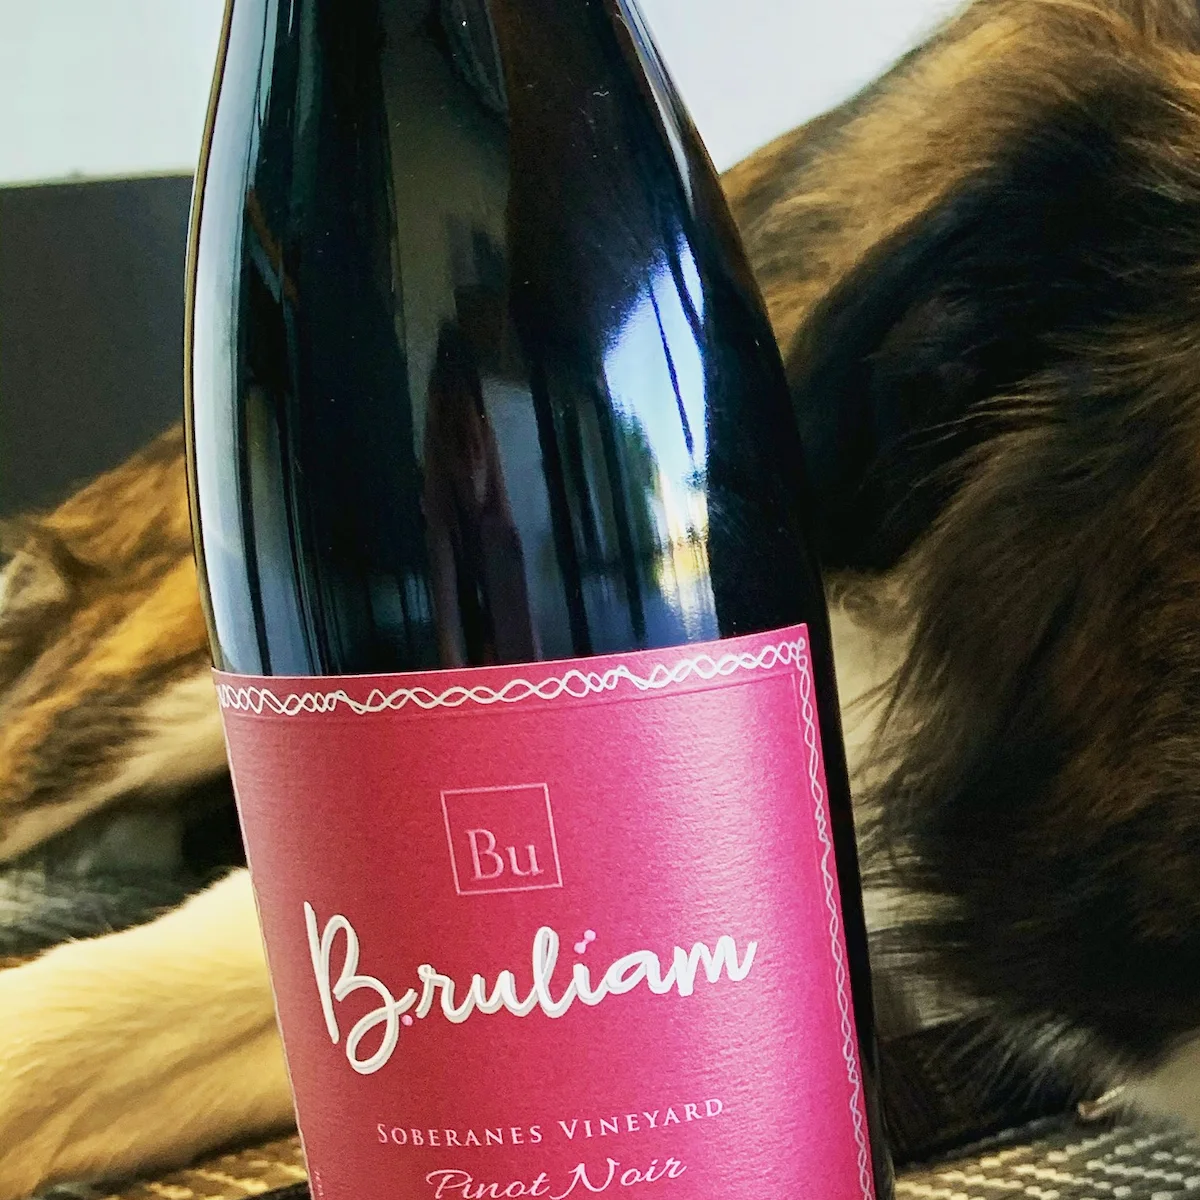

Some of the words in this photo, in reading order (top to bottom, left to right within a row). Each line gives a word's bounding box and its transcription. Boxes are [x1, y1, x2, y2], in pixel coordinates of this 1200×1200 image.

[466, 828, 543, 879] Bu
[304, 900, 758, 1075] Bruliam
[376, 1122, 544, 1147] SOBERANES
[558, 1098, 725, 1140] VINEYARD
[425, 1168, 552, 1200] Pinot
[549, 1157, 687, 1200] Noir
